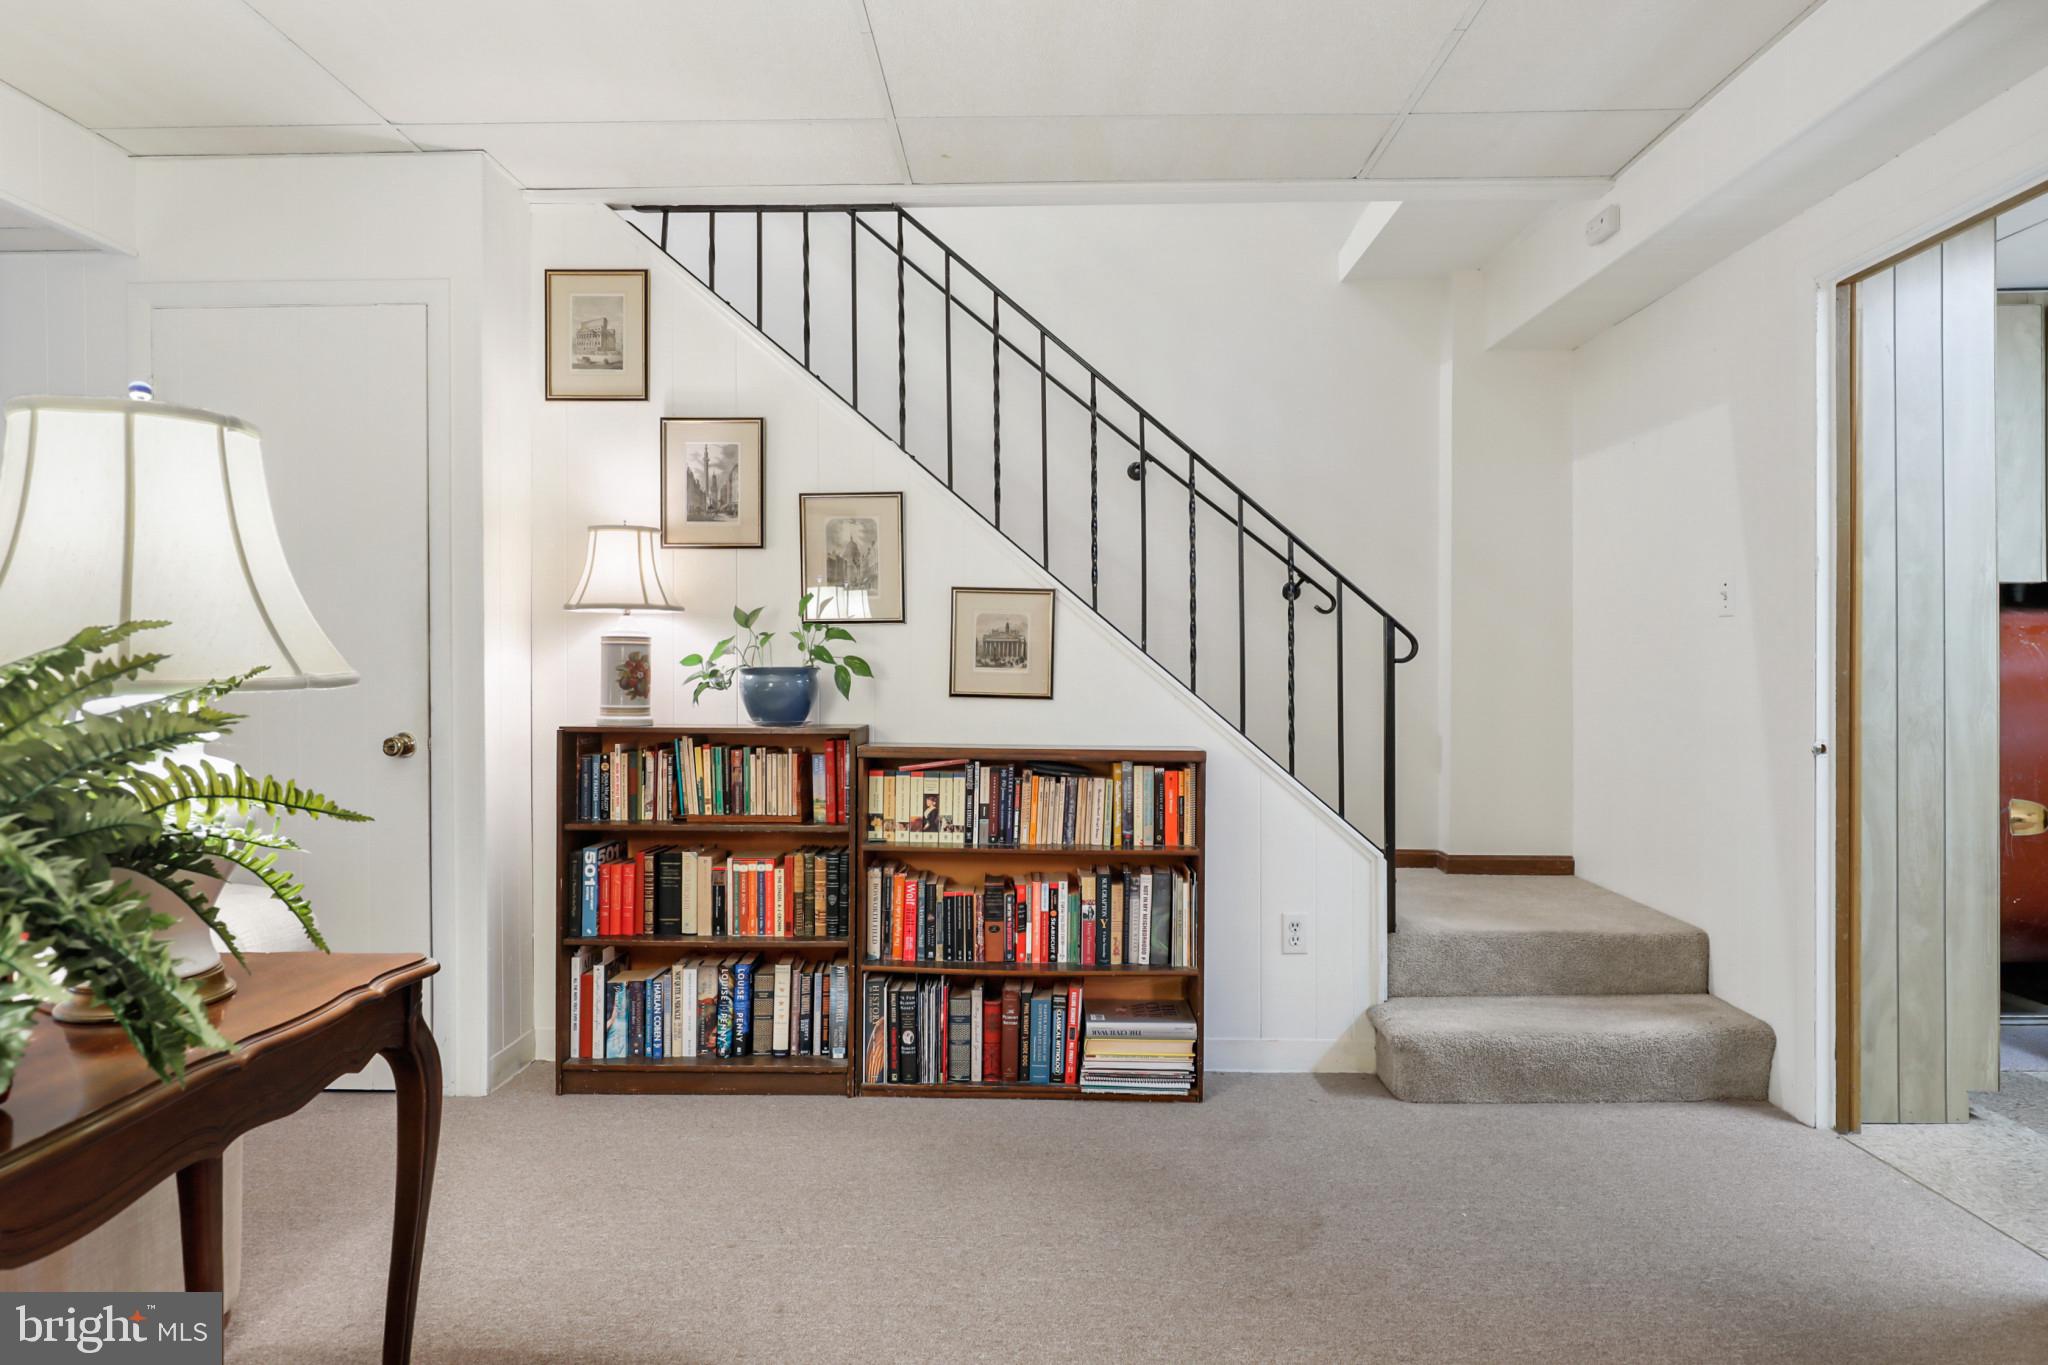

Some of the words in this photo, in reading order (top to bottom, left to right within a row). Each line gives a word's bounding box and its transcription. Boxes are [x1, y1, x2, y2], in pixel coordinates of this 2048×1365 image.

[584, 851, 596, 886] 501
[906, 883, 915, 906] Wolf
[1143, 903, 1148, 912] MY
